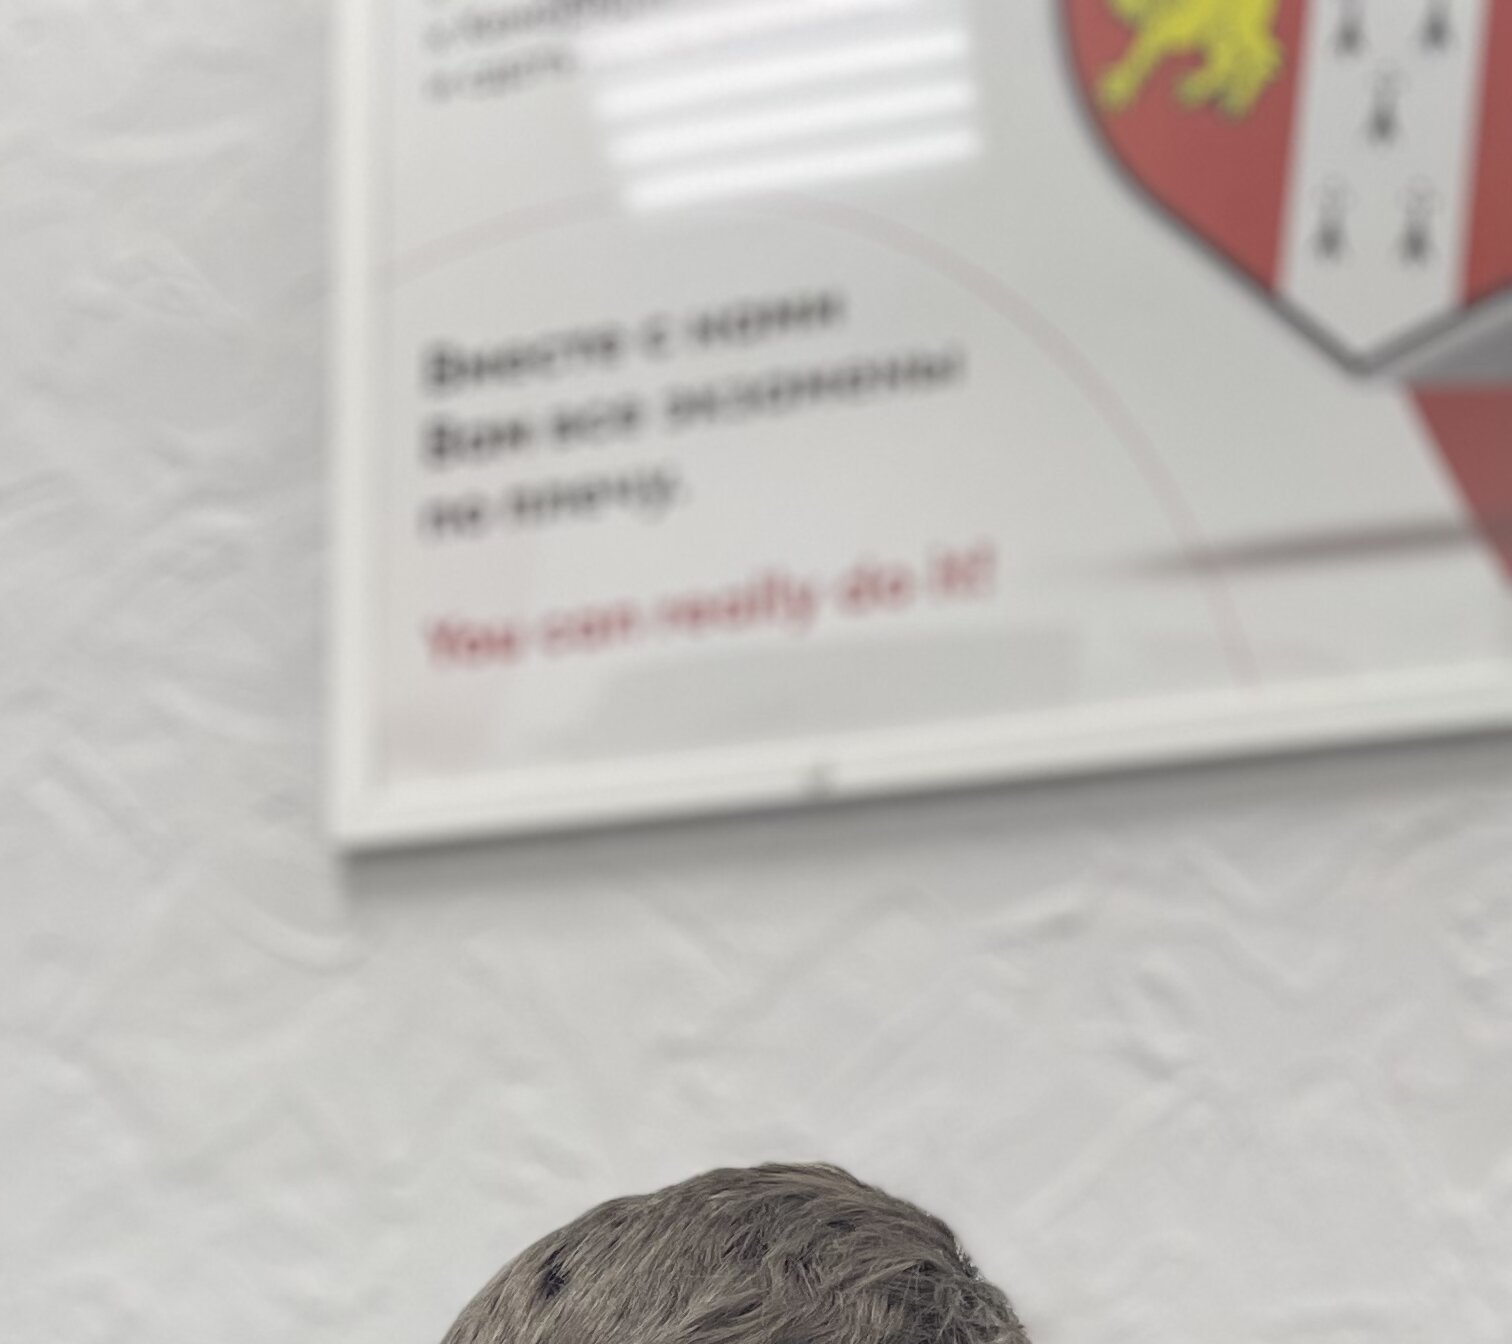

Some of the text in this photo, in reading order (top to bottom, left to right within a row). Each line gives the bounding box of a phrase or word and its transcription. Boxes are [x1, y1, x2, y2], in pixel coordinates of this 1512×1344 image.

[426, 617, 523, 667] You
[540, 602, 641, 655] can
[655, 570, 819, 634] really
[837, 558, 914, 614] do
